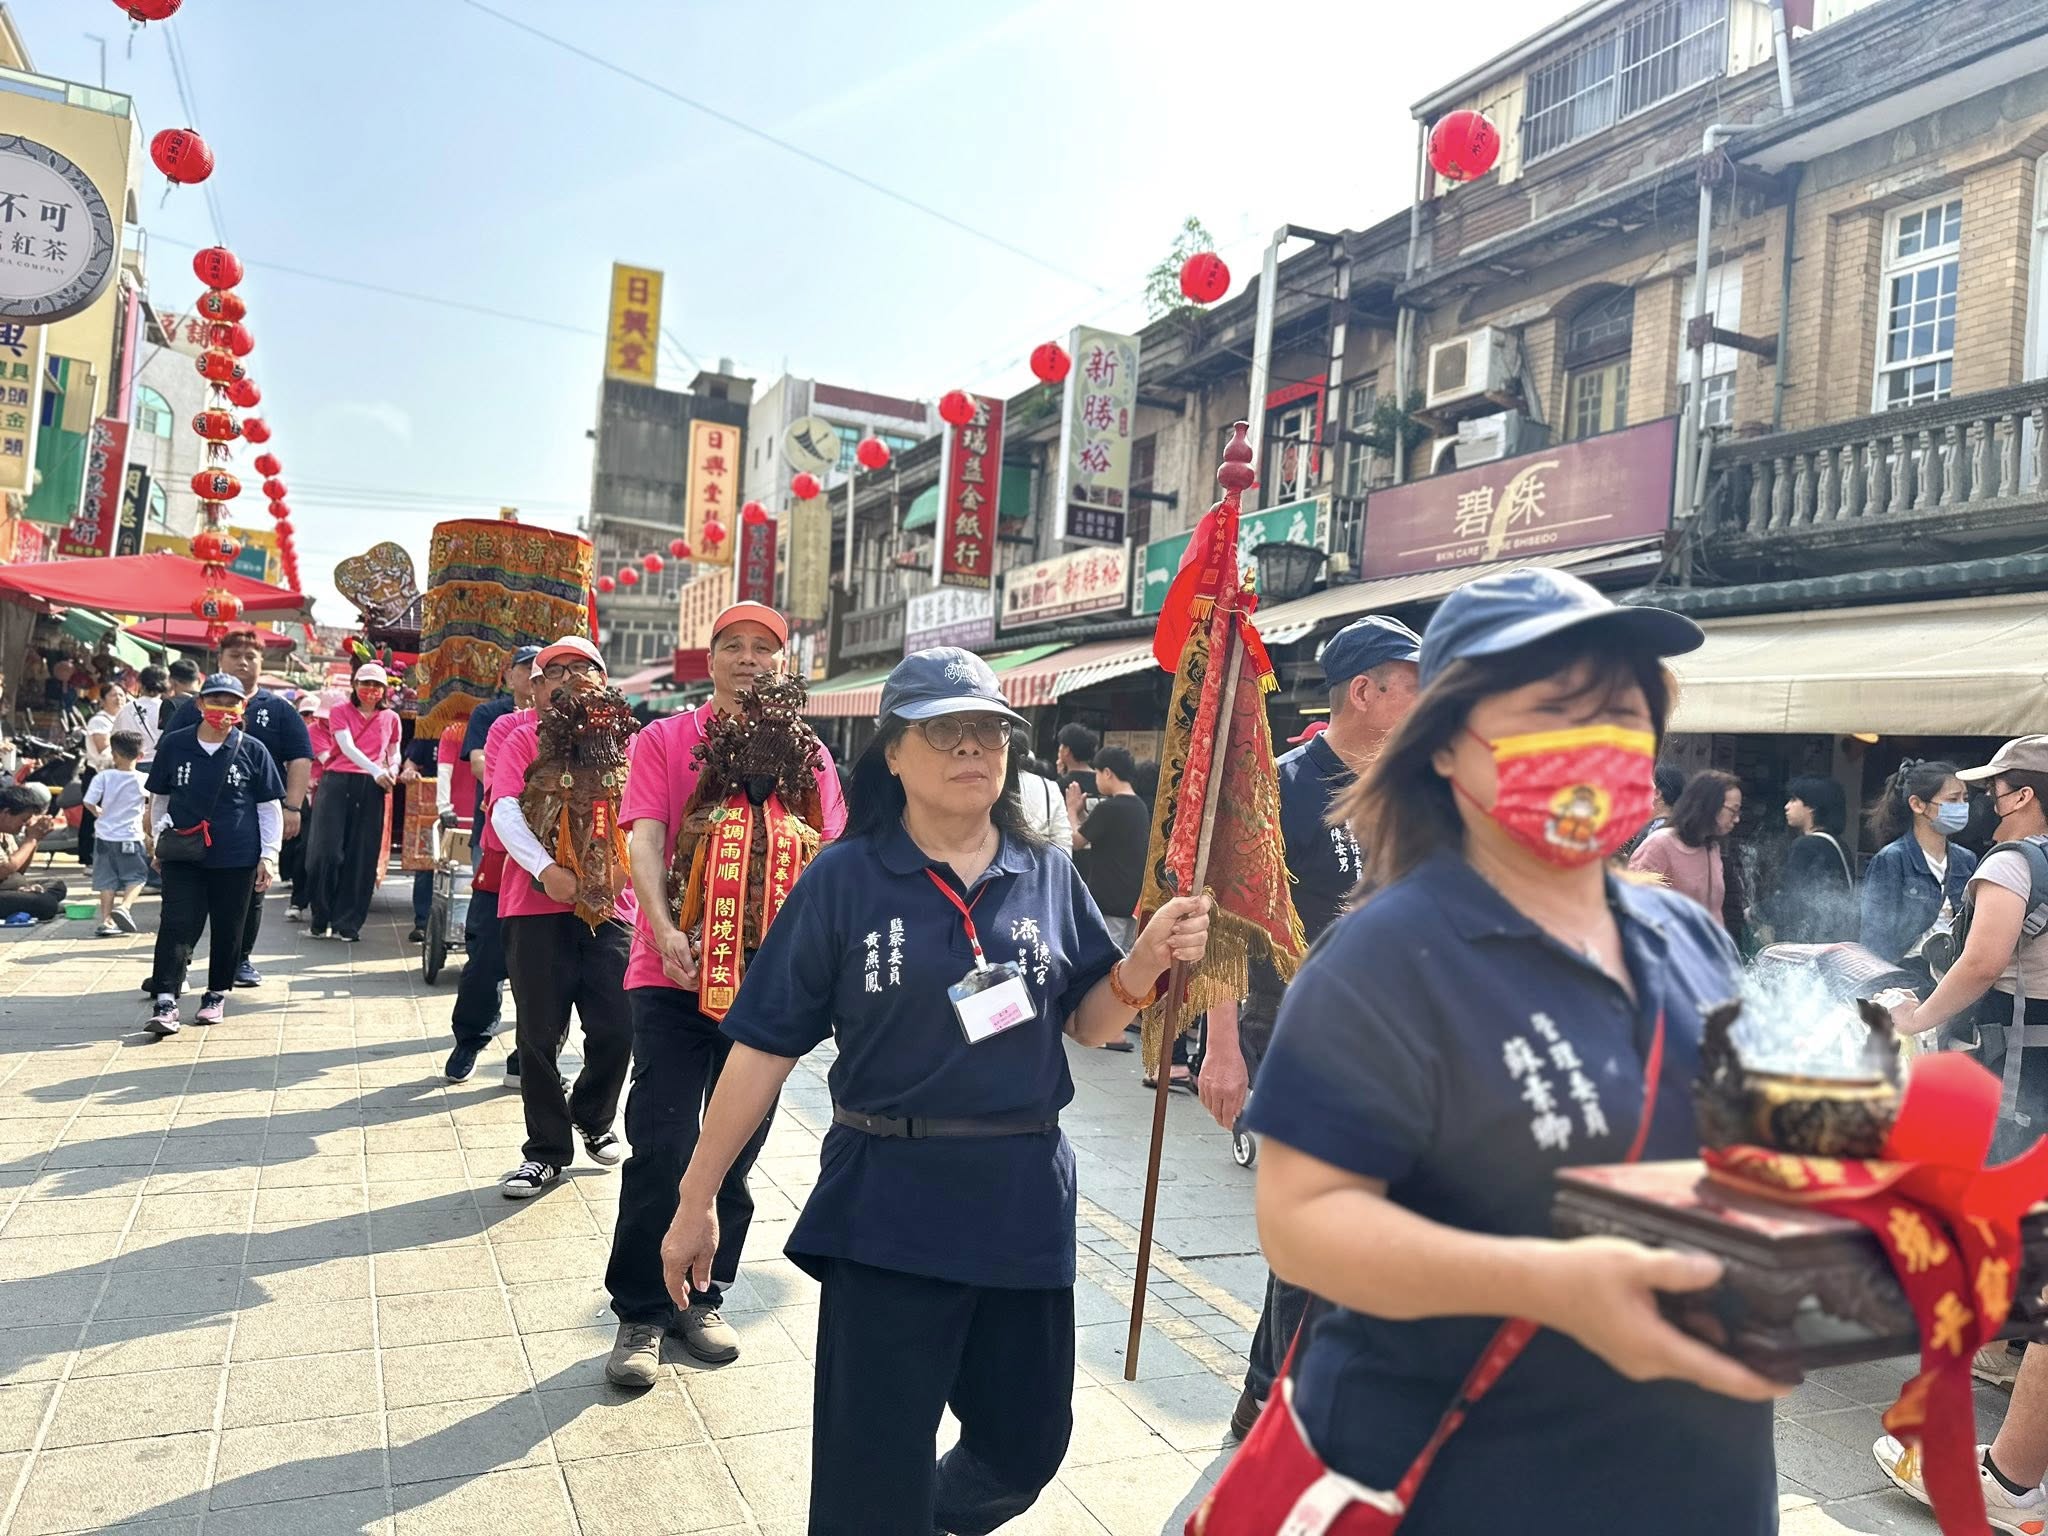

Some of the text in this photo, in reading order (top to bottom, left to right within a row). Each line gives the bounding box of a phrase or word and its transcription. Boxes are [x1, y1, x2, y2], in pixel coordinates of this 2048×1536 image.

[0, 187, 72, 232] 不可
[0, 230, 68, 262] 紅茶
[17, 260, 65, 276] COMPANY
[619, 275, 651, 373] 日興堂
[1078, 345, 1120, 474] 新勝裕
[1064, 556, 1120, 595] 新勝裕
[1436, 551, 1455, 562] SKIN
[1456, 545, 1480, 559] CARE
[716, 807, 747, 882] 風調雨順
[863, 931, 883, 993] 黃燕鳳
[888, 917, 905, 986] 監察委員
[1011, 917, 1051, 986] 濟德宮
